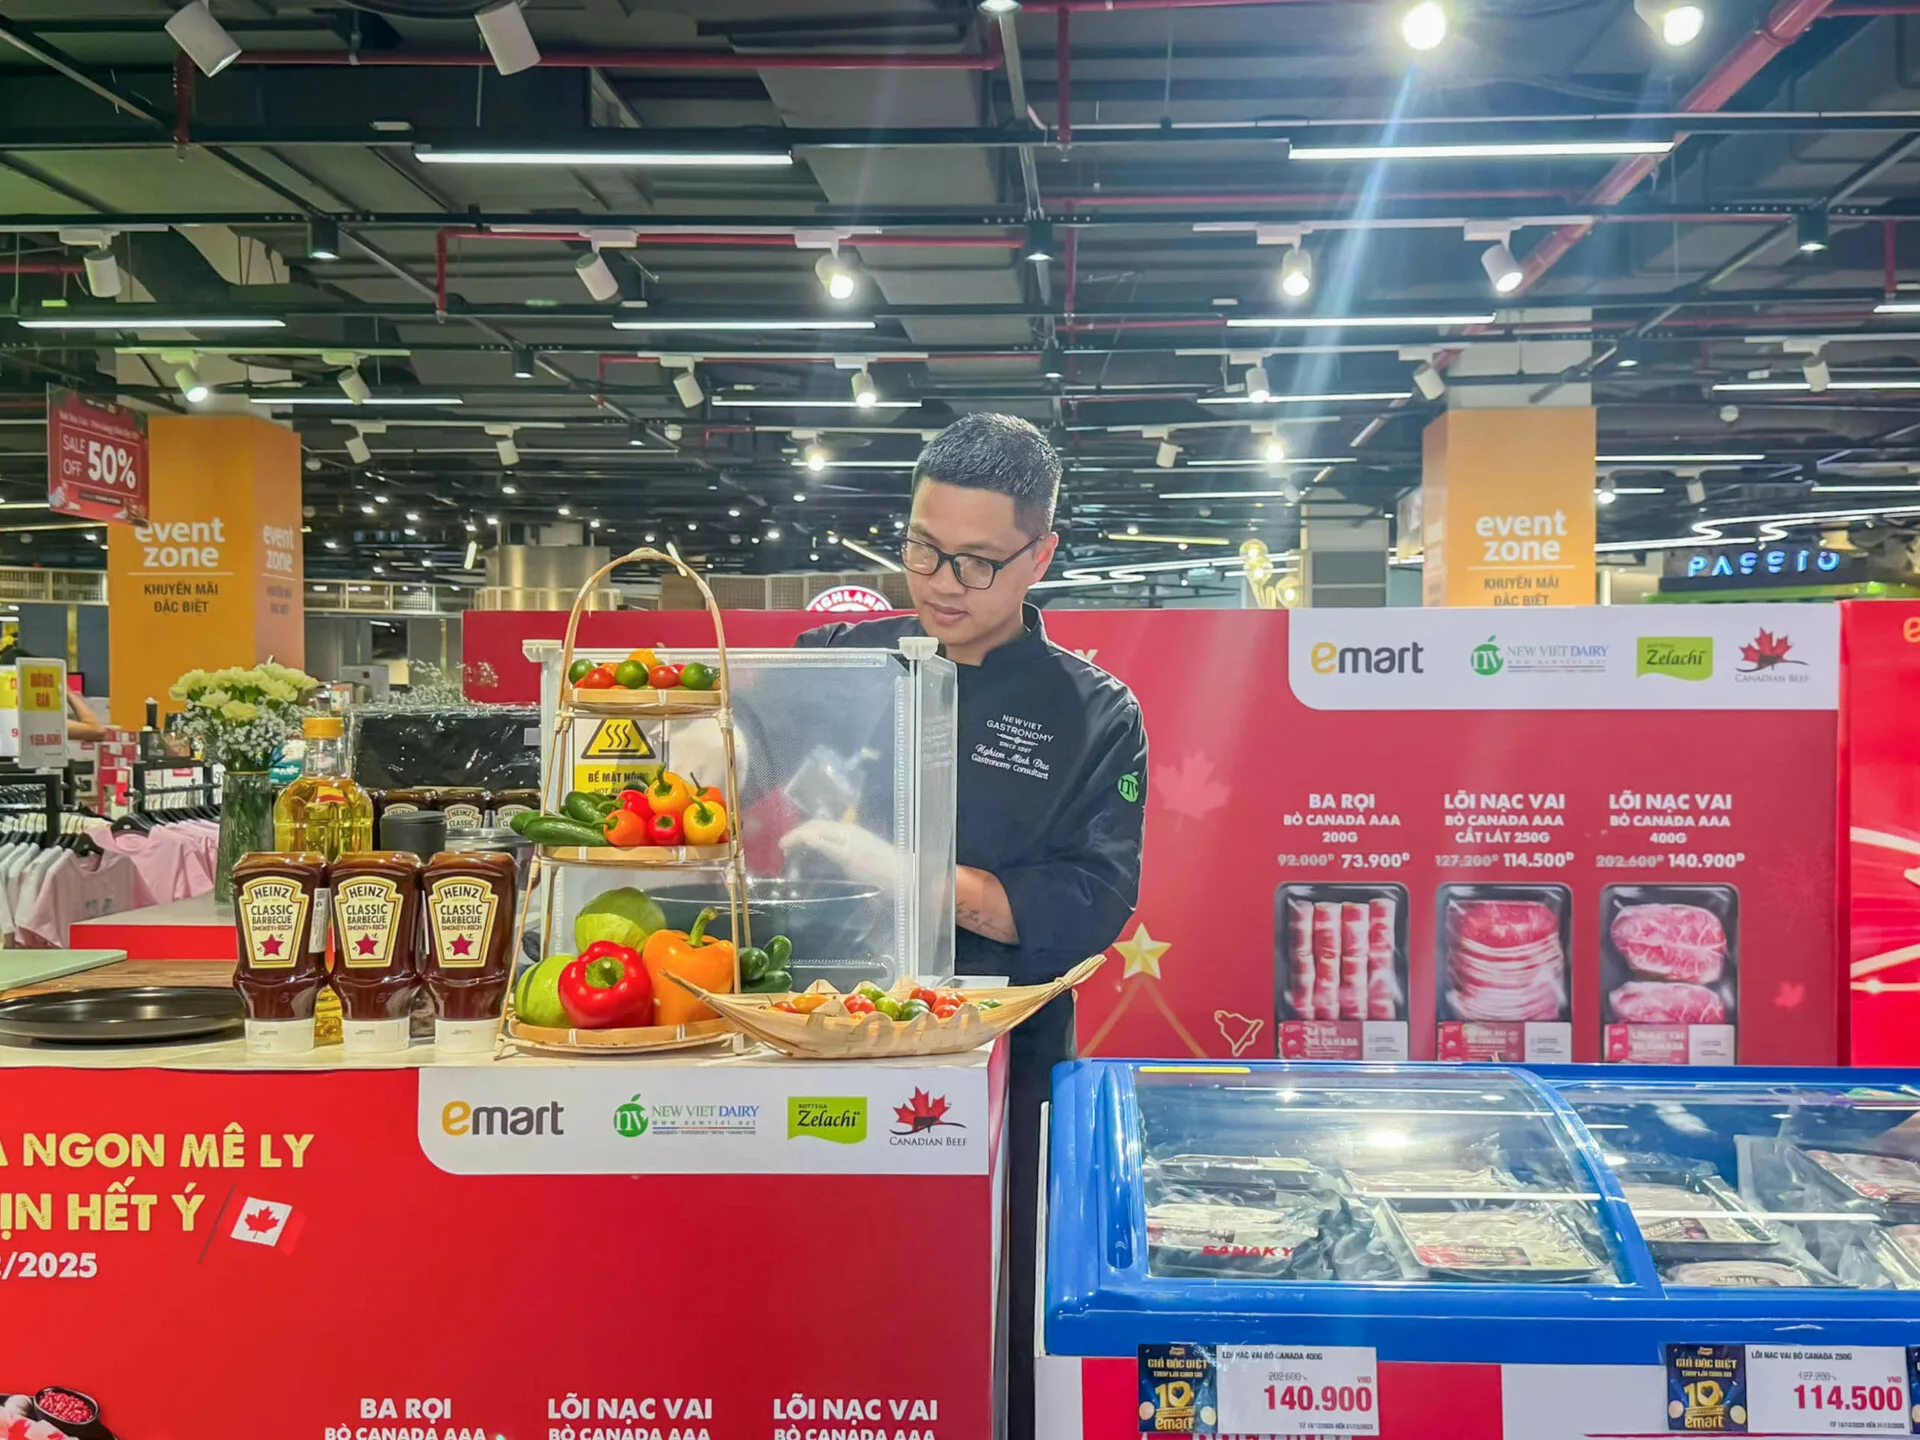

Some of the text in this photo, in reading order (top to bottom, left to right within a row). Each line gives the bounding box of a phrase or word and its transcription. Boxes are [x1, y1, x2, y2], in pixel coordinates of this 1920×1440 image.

[62, 434, 136, 489] SALE 50%
[63, 458, 83, 477] OFF
[134, 516, 225, 543] event
[1475, 508, 1567, 537] event
[262, 524, 294, 550] event
[143, 546, 219, 568] zone
[1483, 540, 1561, 561] zone
[266, 550, 293, 573] zone
[1310, 641, 1424, 675] emart
[1507, 645, 1537, 657] NEW
[1540, 645, 1570, 657] VIET
[1571, 645, 1609, 657] DAIRY
[1646, 649, 1706, 666] Zelachi
[1734, 673, 1809, 684] CANADIAN BEEF
[986, 720, 1054, 742] GASTRONOMY
[971, 753, 1049, 780] Gastronomy Consultant
[1309, 793, 1376, 812] BA RỌI
[1444, 790, 1566, 813] LÕI NẠC VAI
[1609, 790, 1732, 814] LÕI NẠC VAI
[451, 809, 472, 818] HEINZ
[1283, 811, 1400, 826] BÒ CANADA AAA
[1445, 811, 1564, 826] BÒ CANADA AAA
[1610, 812, 1731, 827] BÒ CANADA AAA
[449, 820, 474, 828] CLASSIC
[1322, 831, 1358, 843] 200G
[1485, 828, 1511, 843] LÁT
[1514, 832, 1550, 843] 250G
[1649, 832, 1687, 844] 400G
[253, 886, 290, 899] HEINZ
[349, 885, 384, 899] HEINZ
[443, 885, 480, 899] HEINZ
[251, 905, 293, 915] CLASSIC
[346, 904, 388, 915] CLASSIC
[440, 904, 483, 915] CLASSIC
[252, 916, 292, 924] BARBECUE
[347, 915, 387, 924] BARBECUE
[441, 915, 482, 924] BARBECUE
[442, 1100, 564, 1136] emart
[652, 1105, 684, 1117] NEW
[686, 1105, 717, 1117] VIET
[719, 1105, 760, 1118] DAIRY
[797, 1110, 861, 1128] Zelachi
[23, 1132, 165, 1168] NGON
[179, 1122, 245, 1168] MÊ
[259, 1133, 314, 1168] LY
[889, 1136, 968, 1147] CANADIAN BEEF
[67, 1176, 157, 1231] HẾT
[171, 1182, 205, 1232] Ý
[1251, 1351, 1263, 1360] VAI
[1275, 1351, 1304, 1361] CANADA
[1305, 1352, 1323, 1361] 400G
[1780, 1351, 1791, 1360] VAI
[1793, 1350, 1803, 1360] BÒ
[1804, 1352, 1833, 1360] CANADA
[1356, 1376, 1371, 1384] VND
[1887, 1376, 1901, 1384] VND
[1264, 1385, 1372, 1412] 140.900
[1794, 1384, 1903, 1411] 114.500
[360, 1397, 452, 1424] BA RỌI
[548, 1392, 712, 1425] LÕI NẠC VAI
[773, 1393, 938, 1426] LÕI NẠC VAI
[1155, 1417, 1194, 1430] emart
[1685, 1415, 1724, 1429] emart
[325, 1422, 487, 1440] BÒ CANADA AAA
[549, 1424, 711, 1440] BÒ CANADA AAA
[774, 1424, 936, 1440] BÒ CANADA AAA
